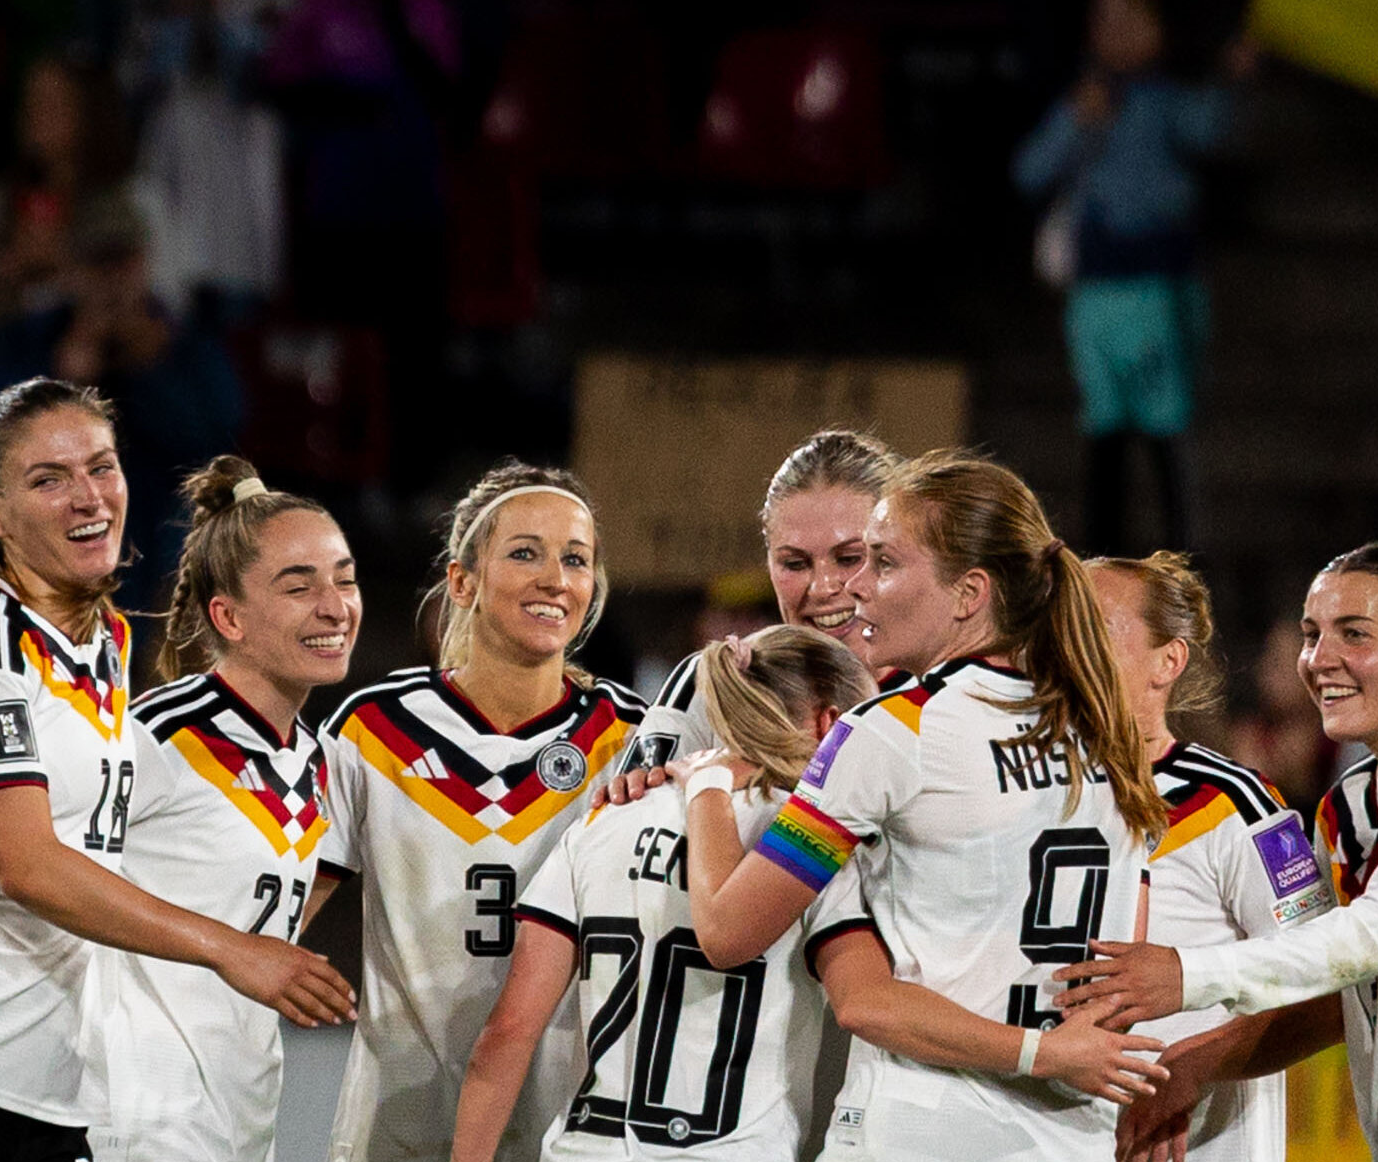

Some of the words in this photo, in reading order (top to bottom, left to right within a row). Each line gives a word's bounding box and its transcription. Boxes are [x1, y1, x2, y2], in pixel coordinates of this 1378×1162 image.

[84, 758, 133, 853] 18
[465, 864, 515, 957] 3
[1006, 827, 1110, 1030] 9
[565, 917, 766, 1148] 20
